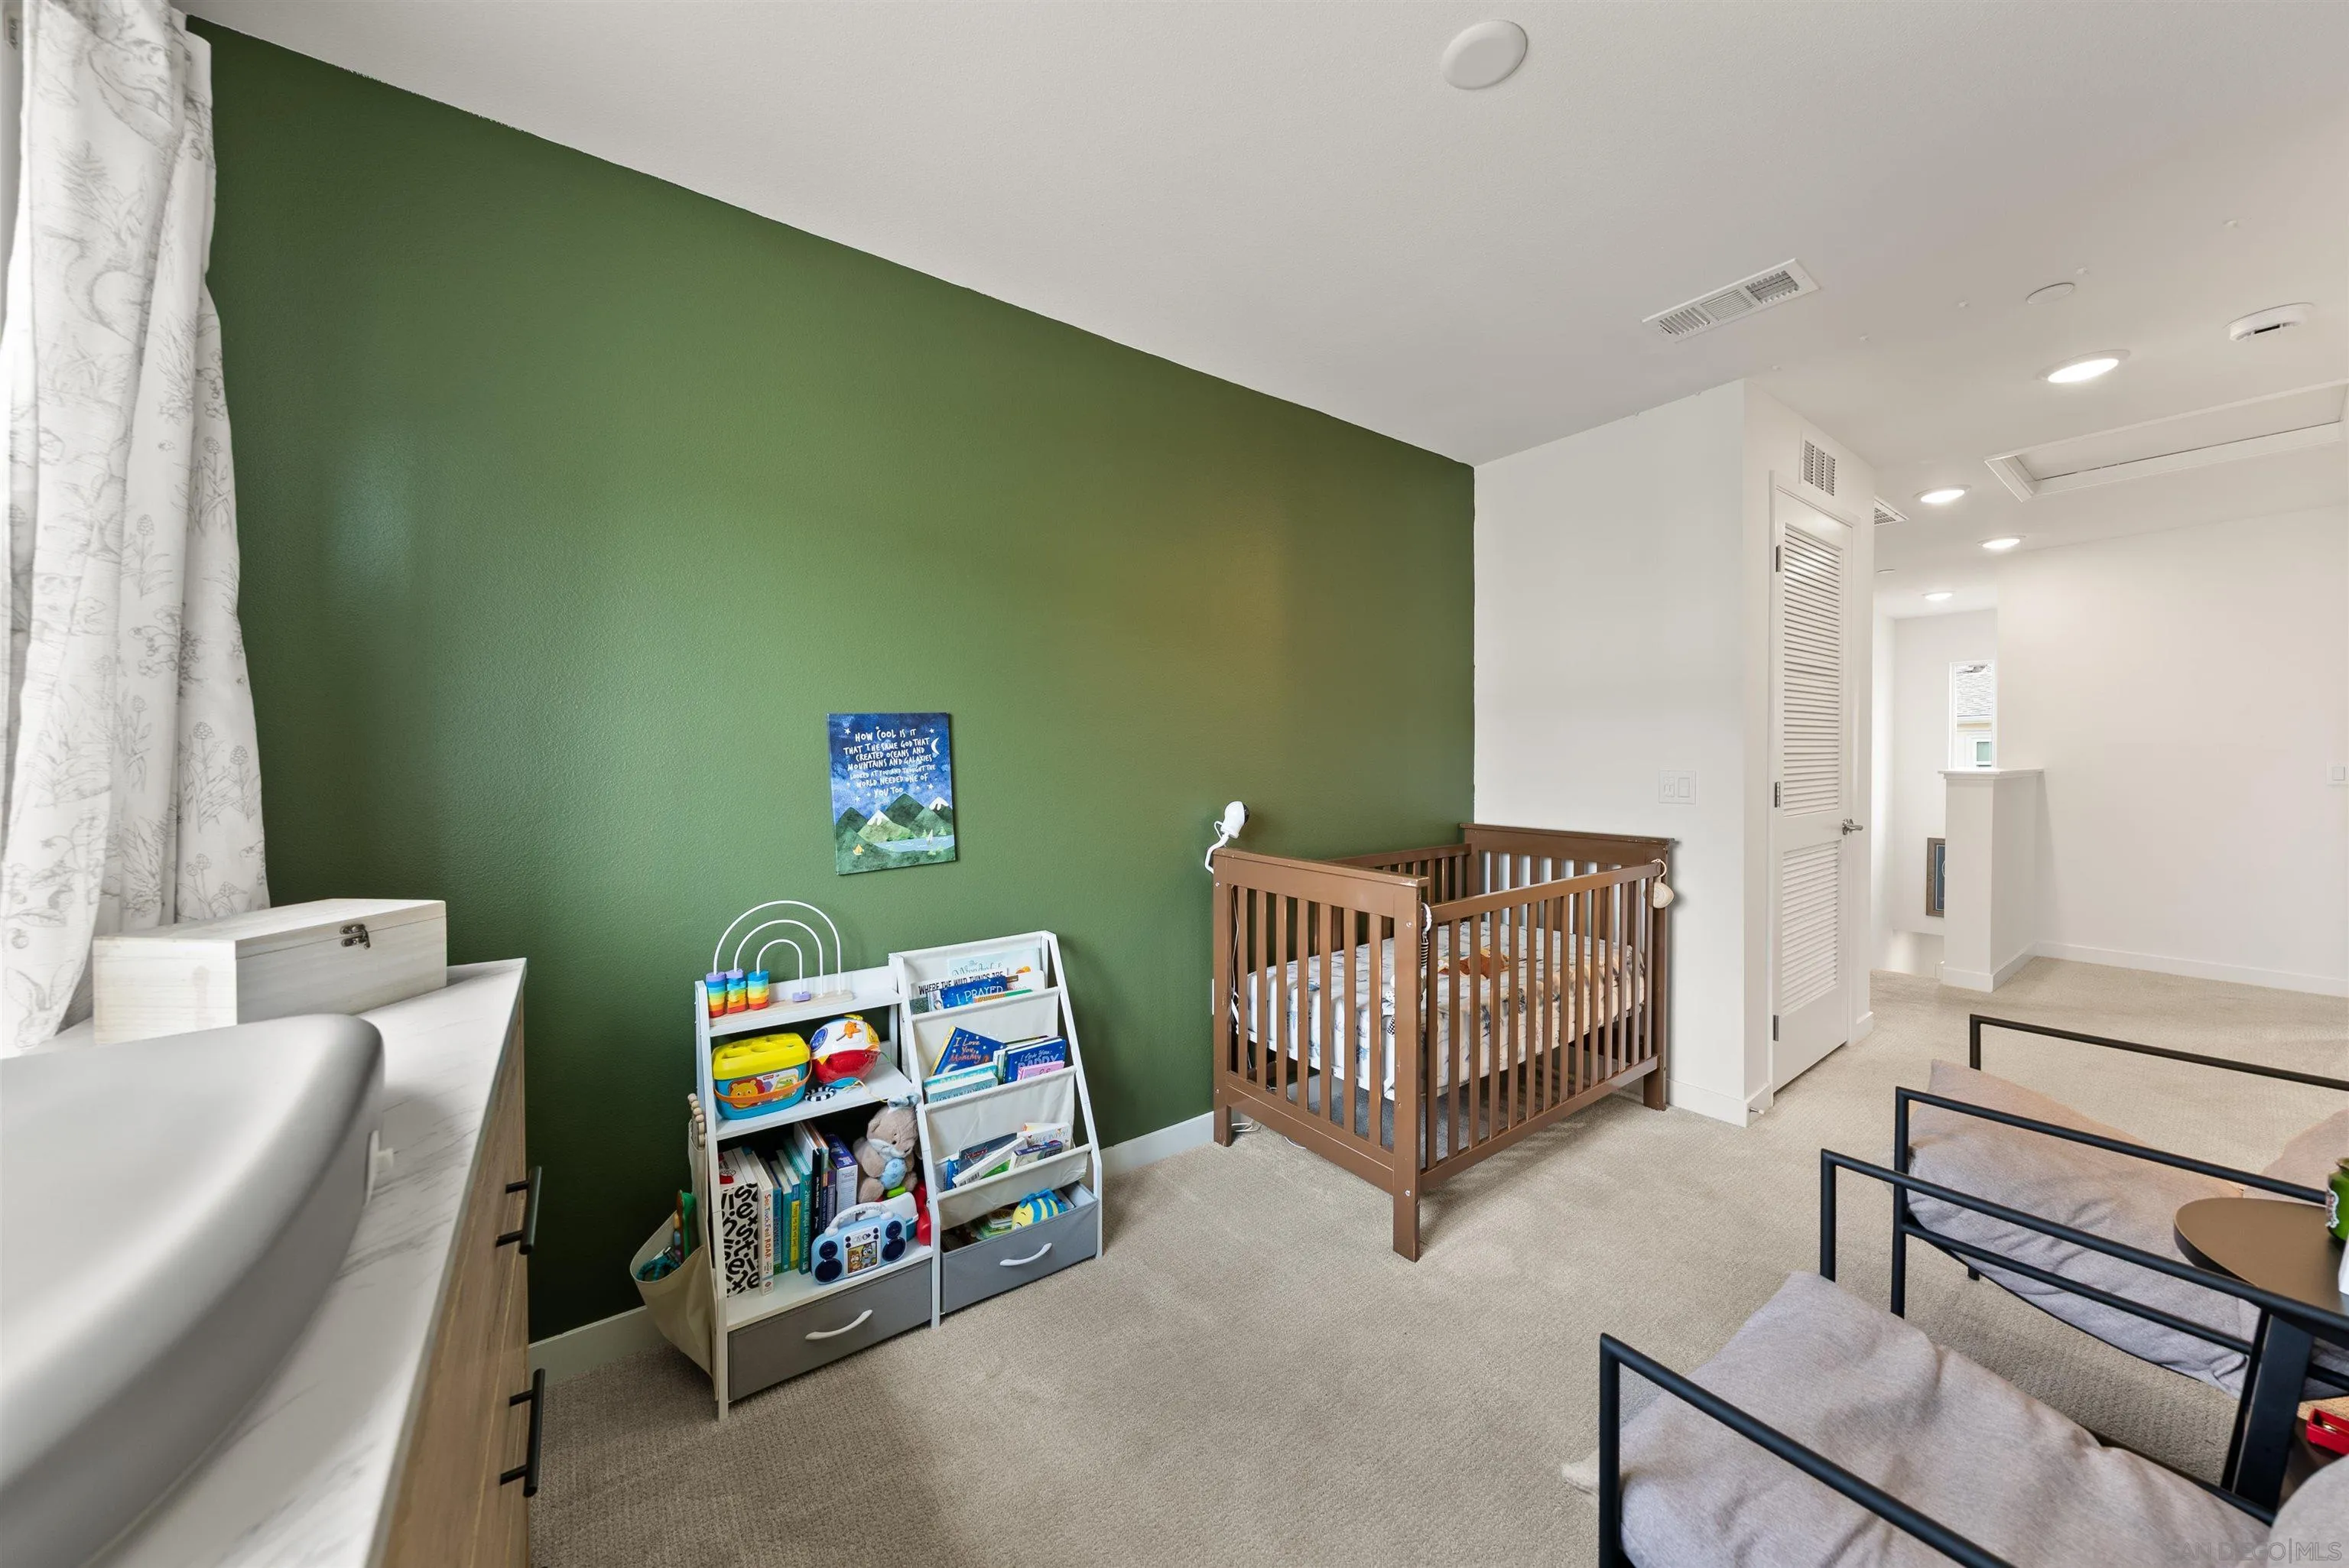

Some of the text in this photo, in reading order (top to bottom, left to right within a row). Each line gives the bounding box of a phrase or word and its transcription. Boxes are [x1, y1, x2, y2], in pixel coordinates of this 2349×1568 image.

[856, 732, 872, 742] HOW
[877, 729, 896, 741] COOL
[900, 729, 905, 738] IS
[843, 745, 863, 755] THAT
[881, 742, 898, 751] SAME
[856, 752, 883, 761] CREATED
[886, 750, 909, 758] OCEANS
[848, 758, 886, 771] MOUNTAINS
[905, 754, 932, 765] GALAXIES
[856, 778, 877, 788] WORLD
[880, 777, 903, 785] NEEDED
[874, 788, 889, 798] YOU
[918, 983, 939, 995] WHERE
[956, 994, 960, 1005] I
[964, 986, 1002, 1002] PRAYED
[954, 1037, 961, 1047] I
